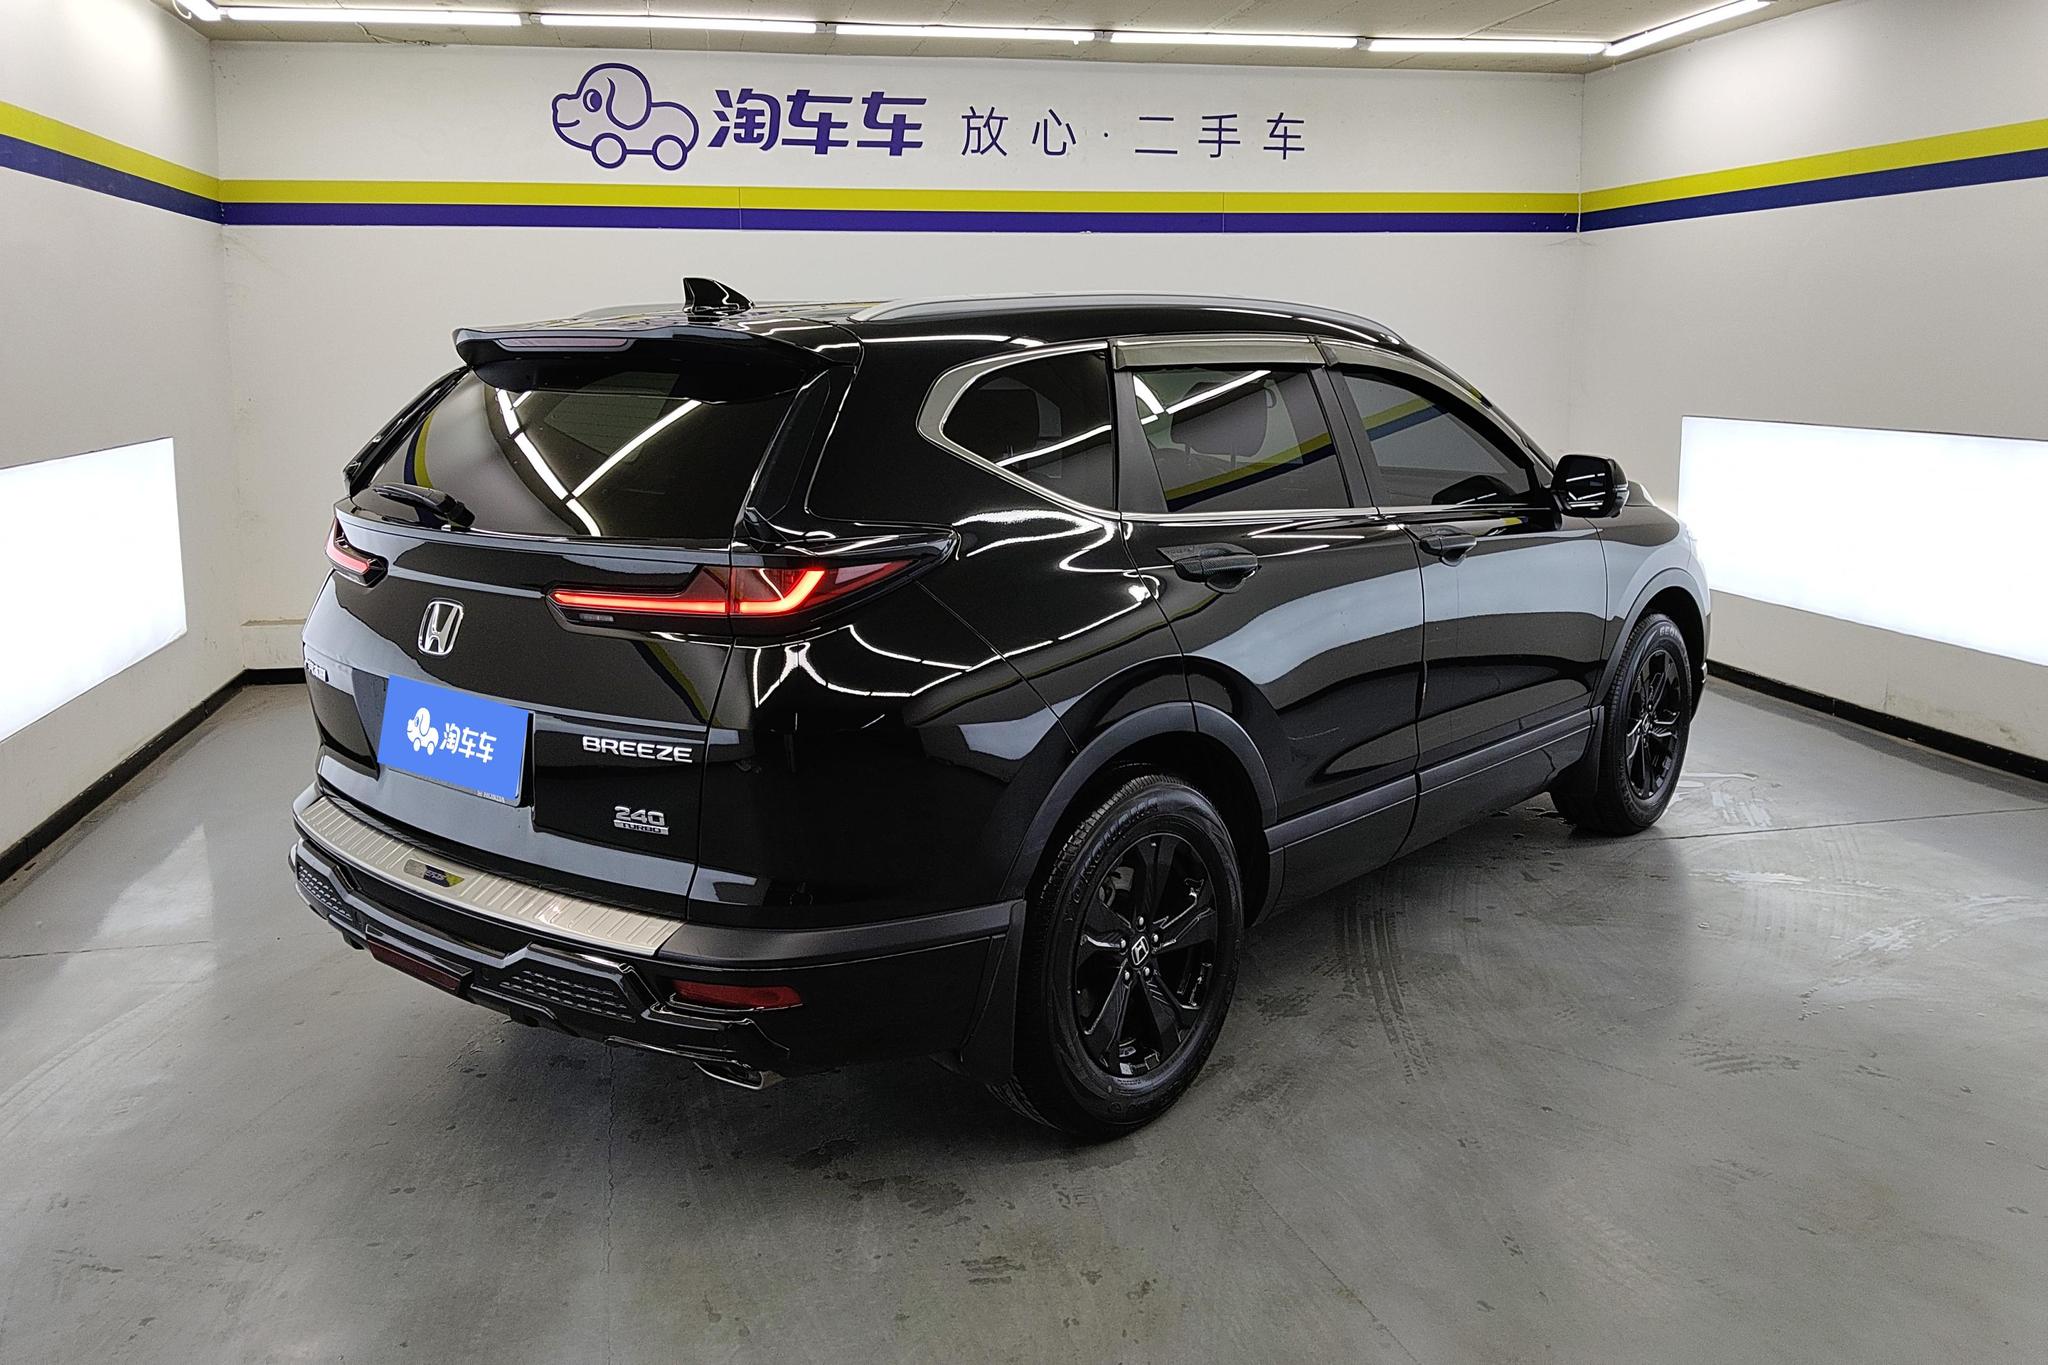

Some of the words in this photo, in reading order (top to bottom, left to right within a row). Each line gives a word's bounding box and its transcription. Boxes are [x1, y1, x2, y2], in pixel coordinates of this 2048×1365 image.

[707, 87, 928, 157] 淘车车
[582, 735, 693, 763] BREEZE
[614, 805, 666, 826] 240
[622, 822, 662, 834] TURBO
